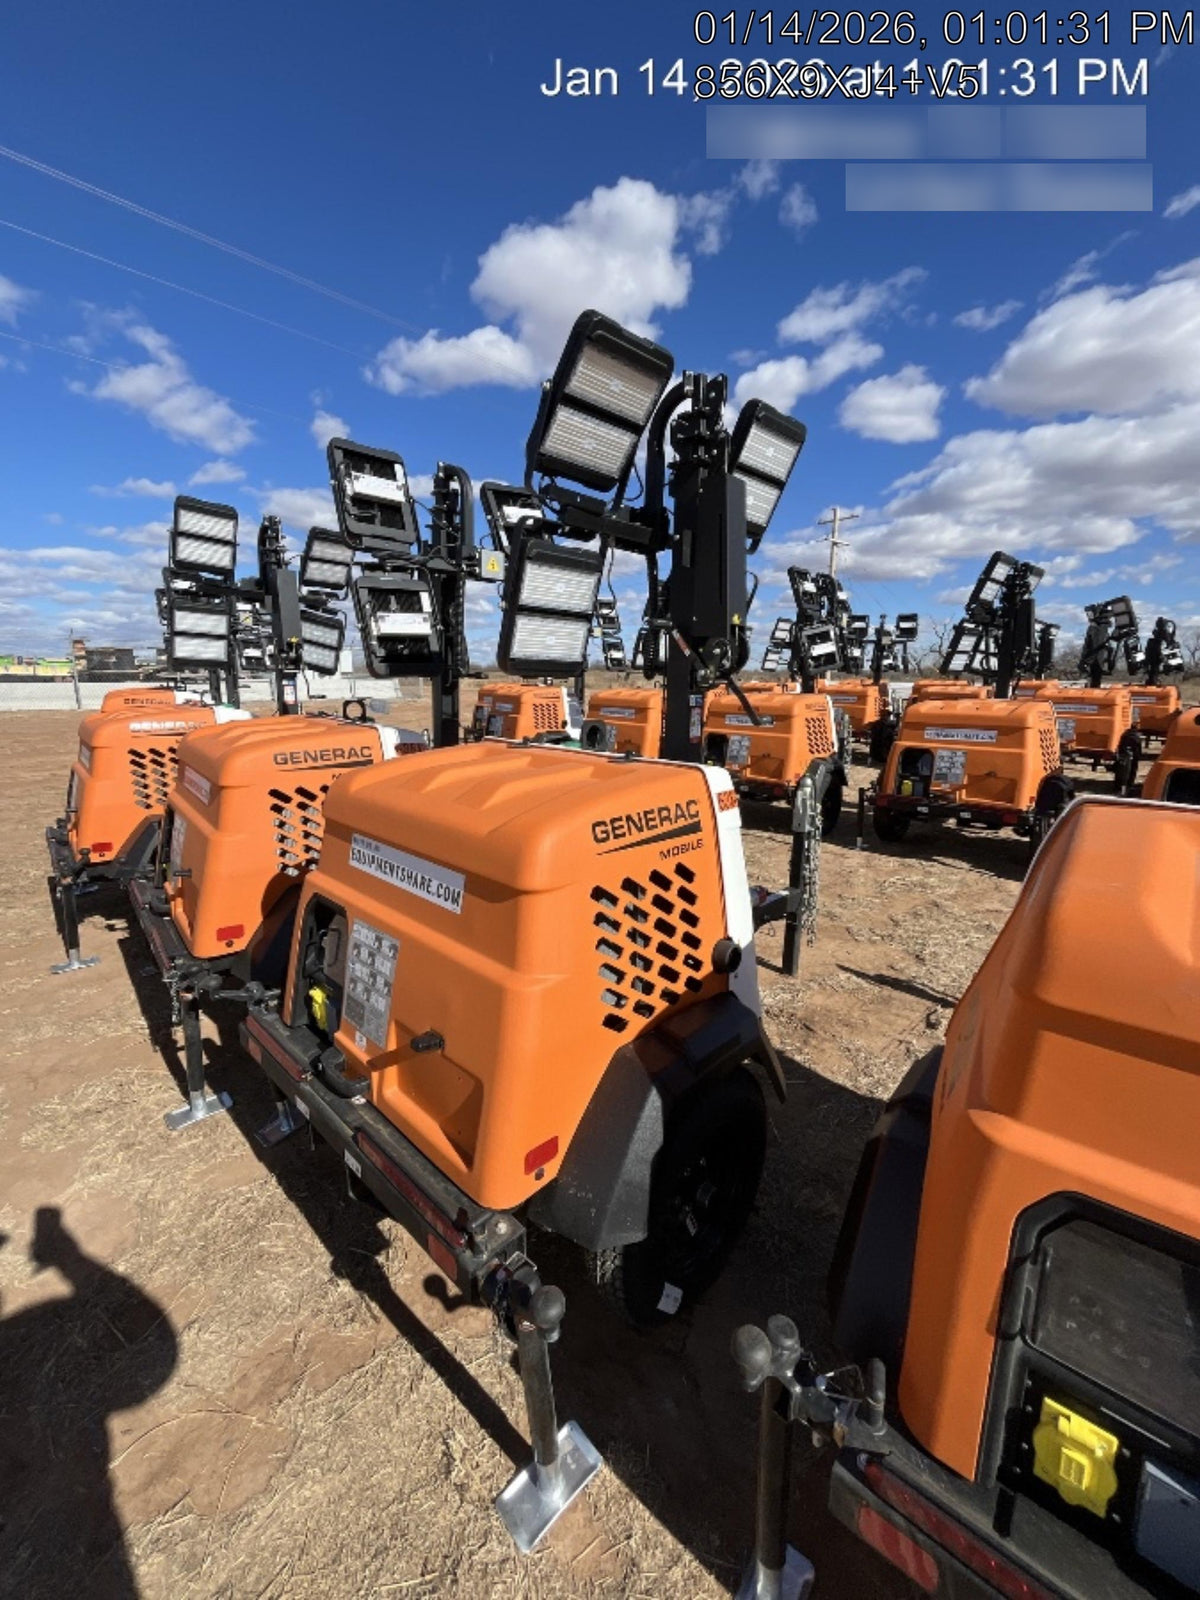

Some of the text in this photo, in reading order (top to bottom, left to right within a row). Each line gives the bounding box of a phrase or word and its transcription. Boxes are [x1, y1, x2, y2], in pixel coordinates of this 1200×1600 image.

[273, 745, 373, 766] GENERAC
[591, 799, 700, 844] GENERAC
[659, 838, 704, 861] MOBILE
